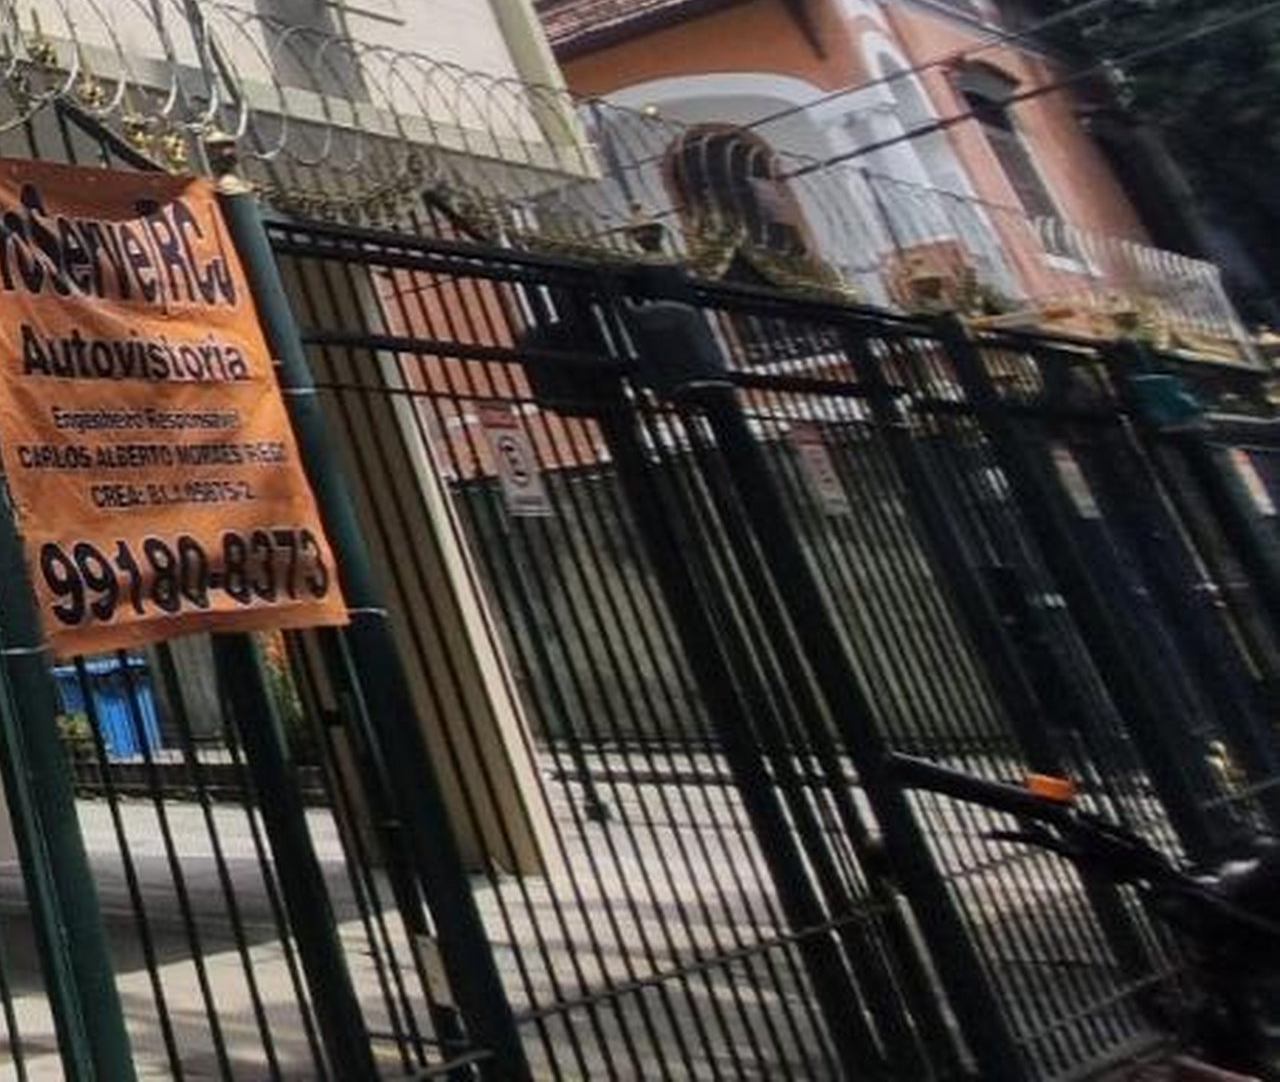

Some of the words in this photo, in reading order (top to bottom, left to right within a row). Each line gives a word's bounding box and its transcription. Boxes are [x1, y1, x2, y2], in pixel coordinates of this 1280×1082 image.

[20, 323, 248, 381] Autovistoria
[18, 444, 92, 469] CARLOS
[96, 443, 173, 468] ALBERTO
[40, 527, 329, 626] 99180-8373
